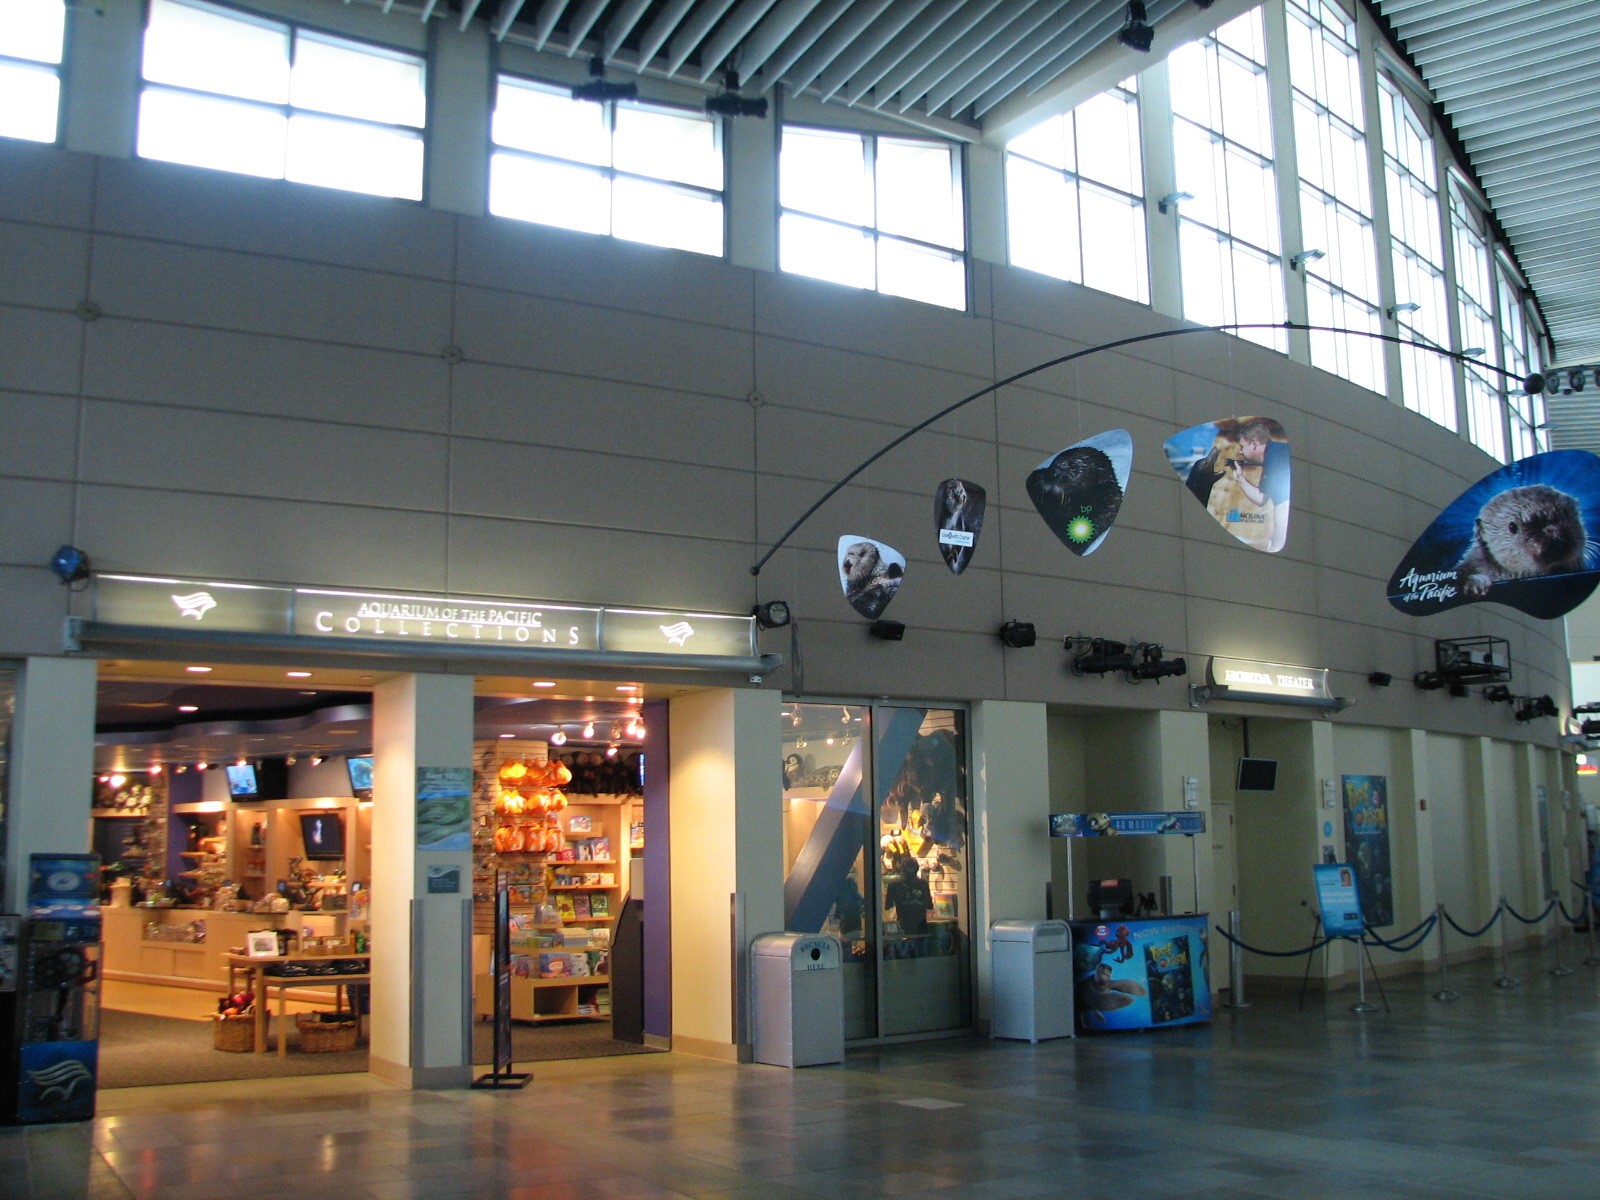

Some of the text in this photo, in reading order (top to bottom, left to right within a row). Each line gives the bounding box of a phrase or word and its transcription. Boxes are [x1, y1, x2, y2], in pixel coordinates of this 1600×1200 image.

[1080, 504, 1093, 514] bp
[1399, 567, 1458, 593] Aquarium
[1419, 582, 1458, 603] Pacific
[357, 602, 543, 625] AQUARIUM OF THE PACIFIC
[315, 611, 580, 646] COLLECTIONS
[1277, 675, 1314, 689] THEATER
[800, 941, 830, 952] RECYCLE
